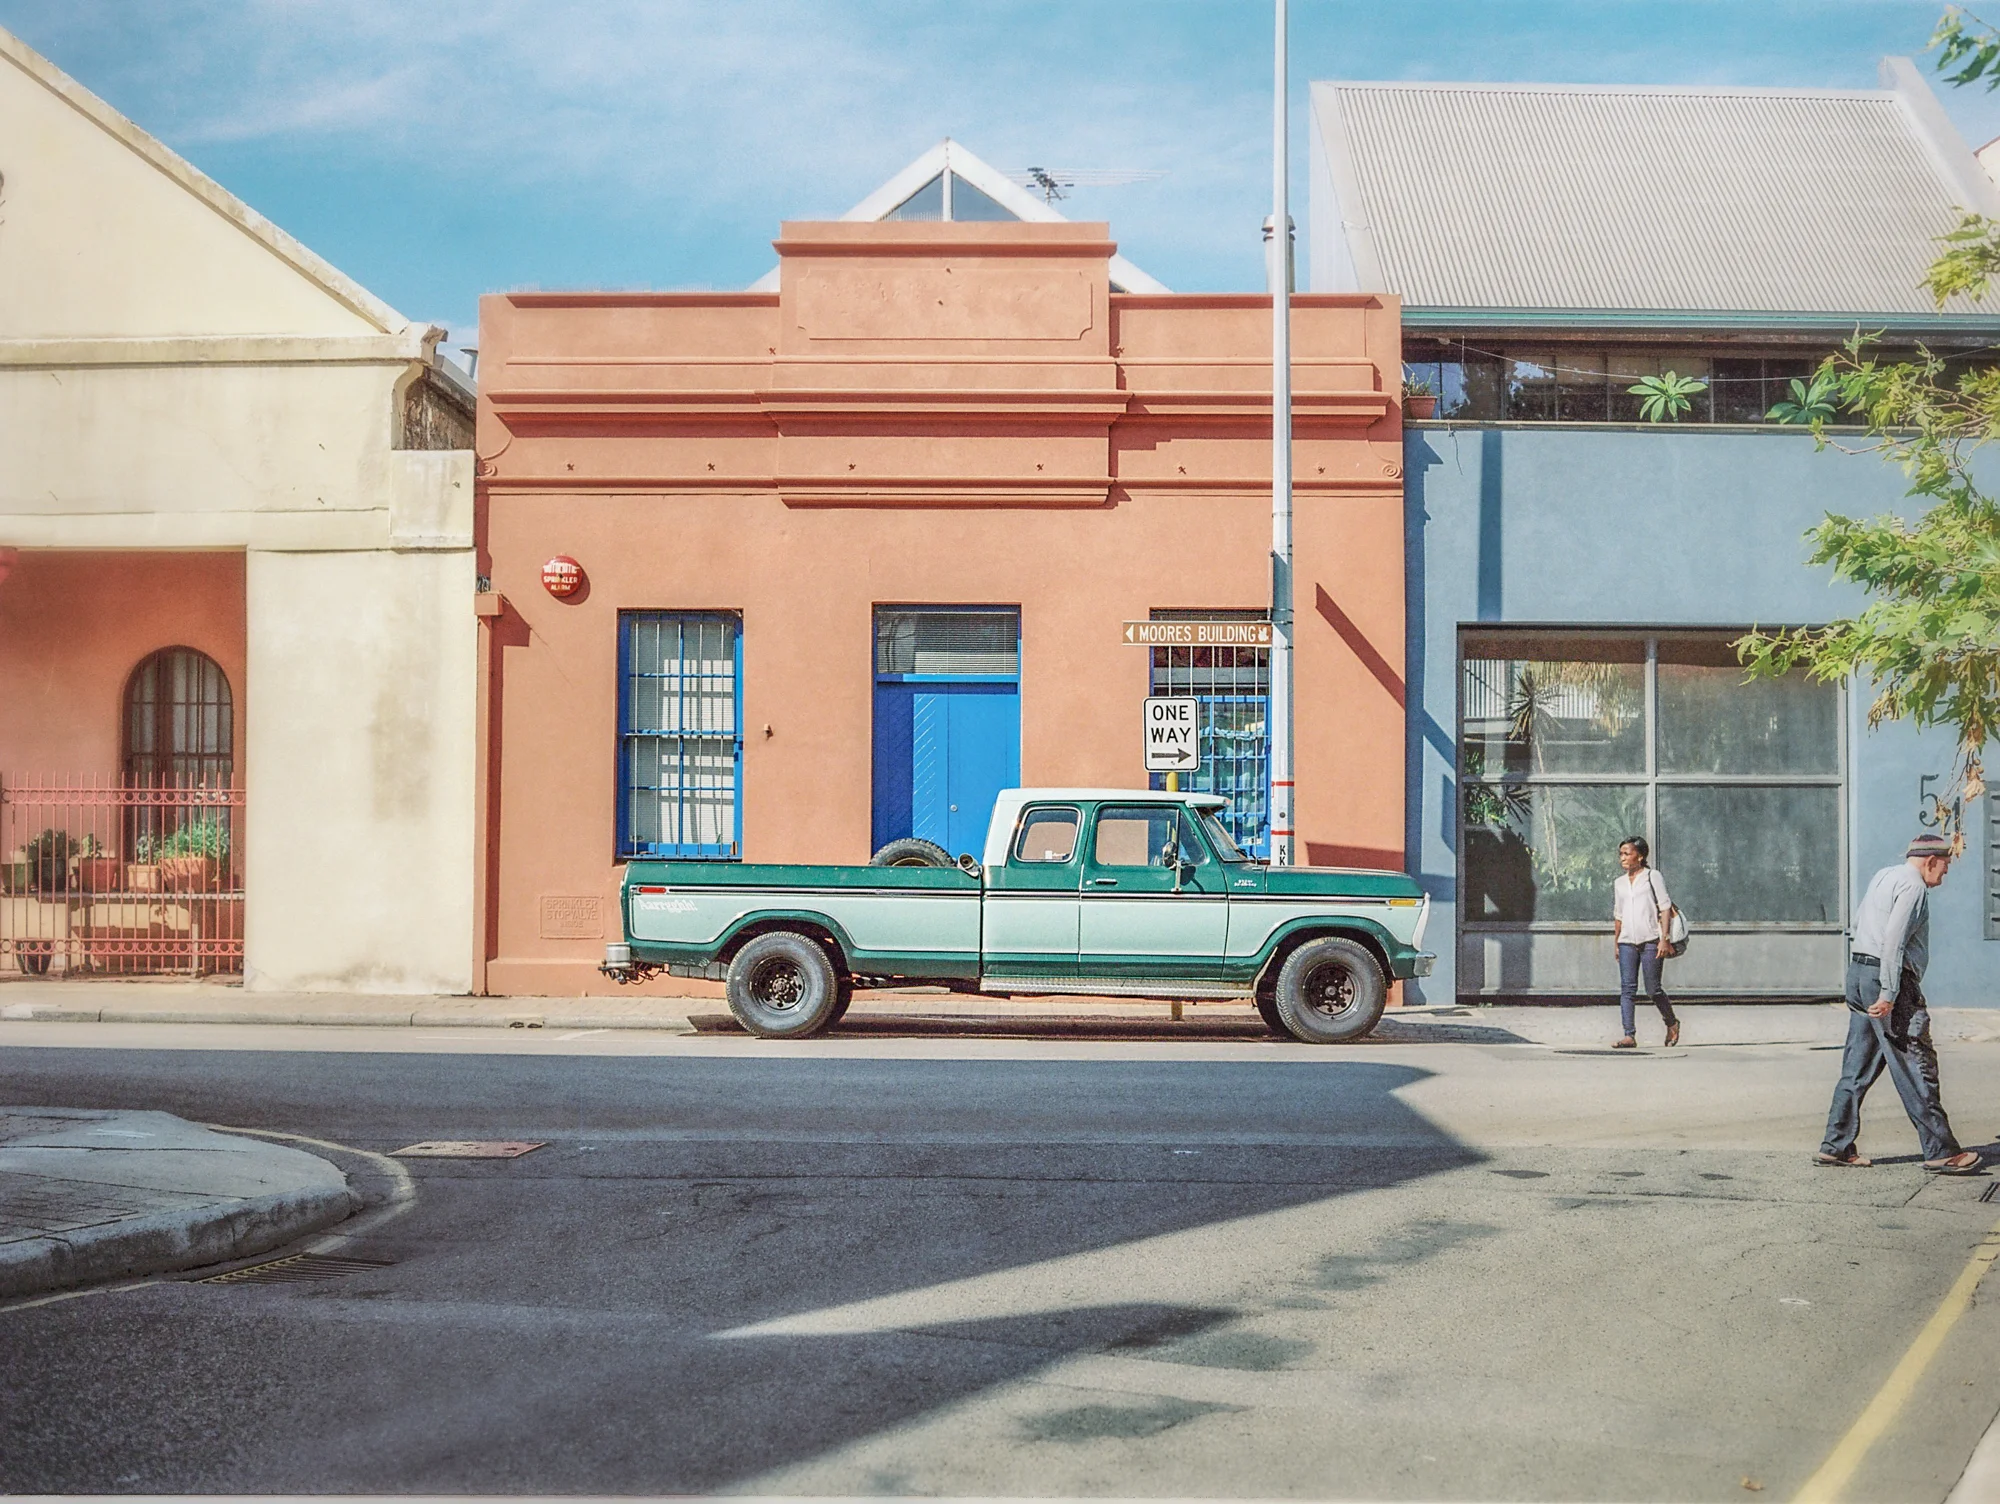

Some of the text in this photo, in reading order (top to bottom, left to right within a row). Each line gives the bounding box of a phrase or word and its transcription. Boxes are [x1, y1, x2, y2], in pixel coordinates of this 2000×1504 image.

[1139, 625, 1256, 643] MOORES BUILDING
[1153, 705, 1189, 721] ONE
[1151, 727, 1191, 743] WAY
[546, 899, 598, 909] SPRINKLER
